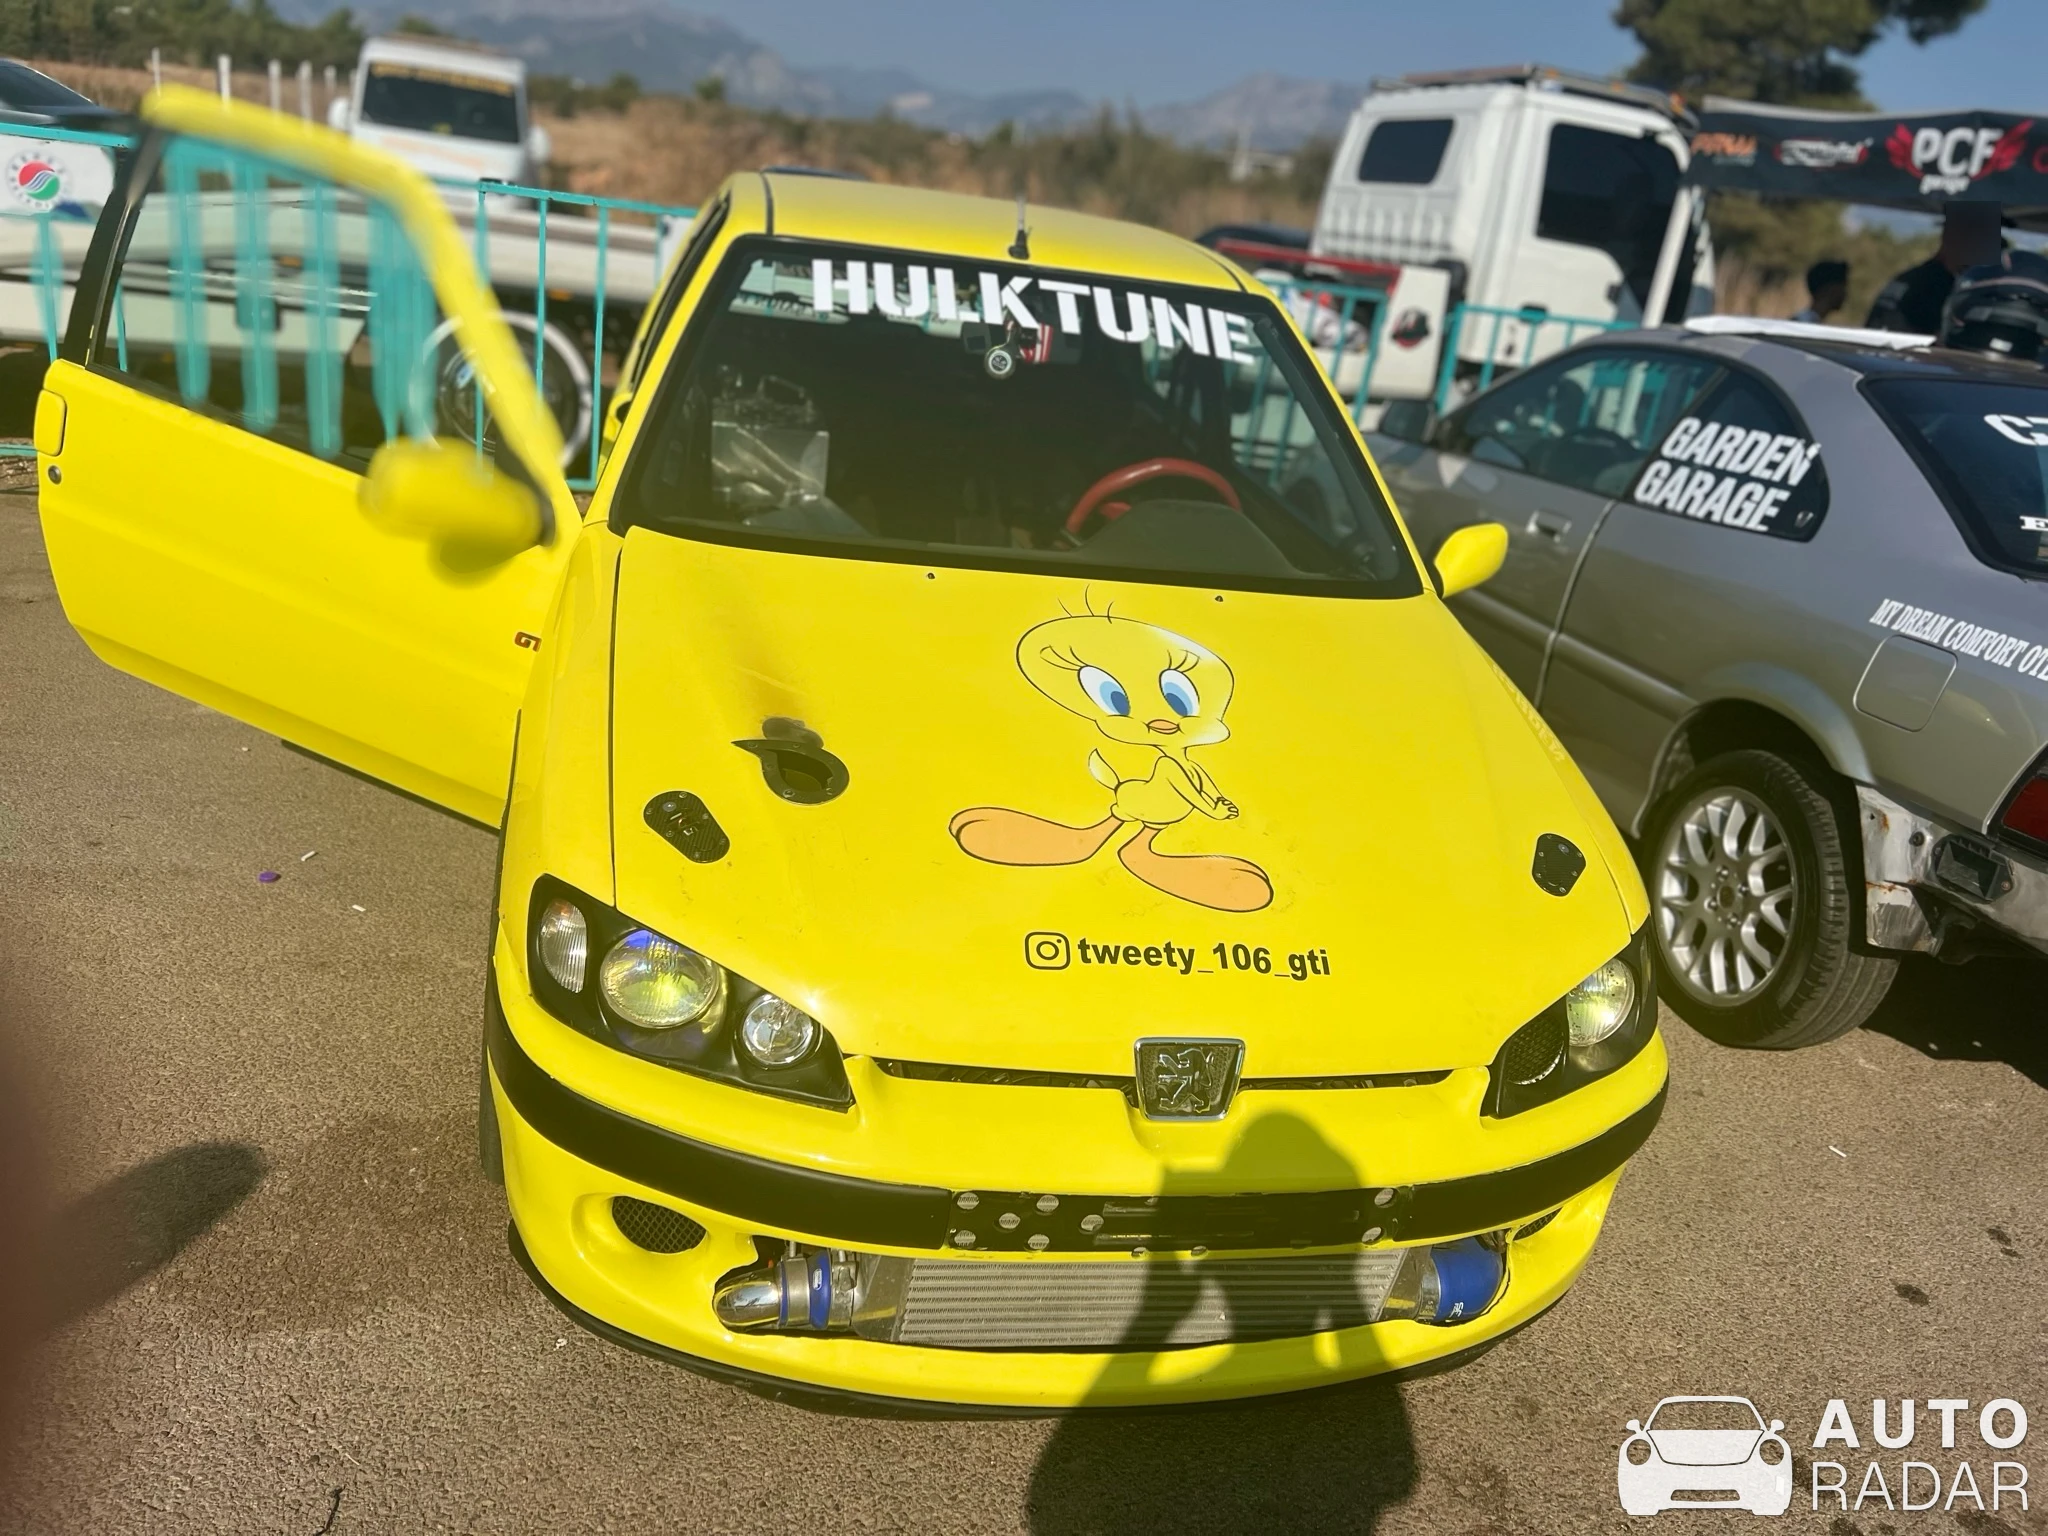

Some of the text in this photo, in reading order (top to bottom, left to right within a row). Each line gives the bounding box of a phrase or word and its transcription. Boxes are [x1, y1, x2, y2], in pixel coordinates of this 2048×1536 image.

[1911, 126, 2004, 178] PCF
[812, 259, 1255, 365] HULKTUNE
[1661, 416, 1821, 487] GARDEN
[1634, 460, 1791, 532] GARAGE
[1869, 598, 1904, 627] MY
[1891, 605, 1954, 644] DREAM
[1943, 621, 2030, 668] COMFORT
[1078, 938, 1330, 981] tweety_106_gti
